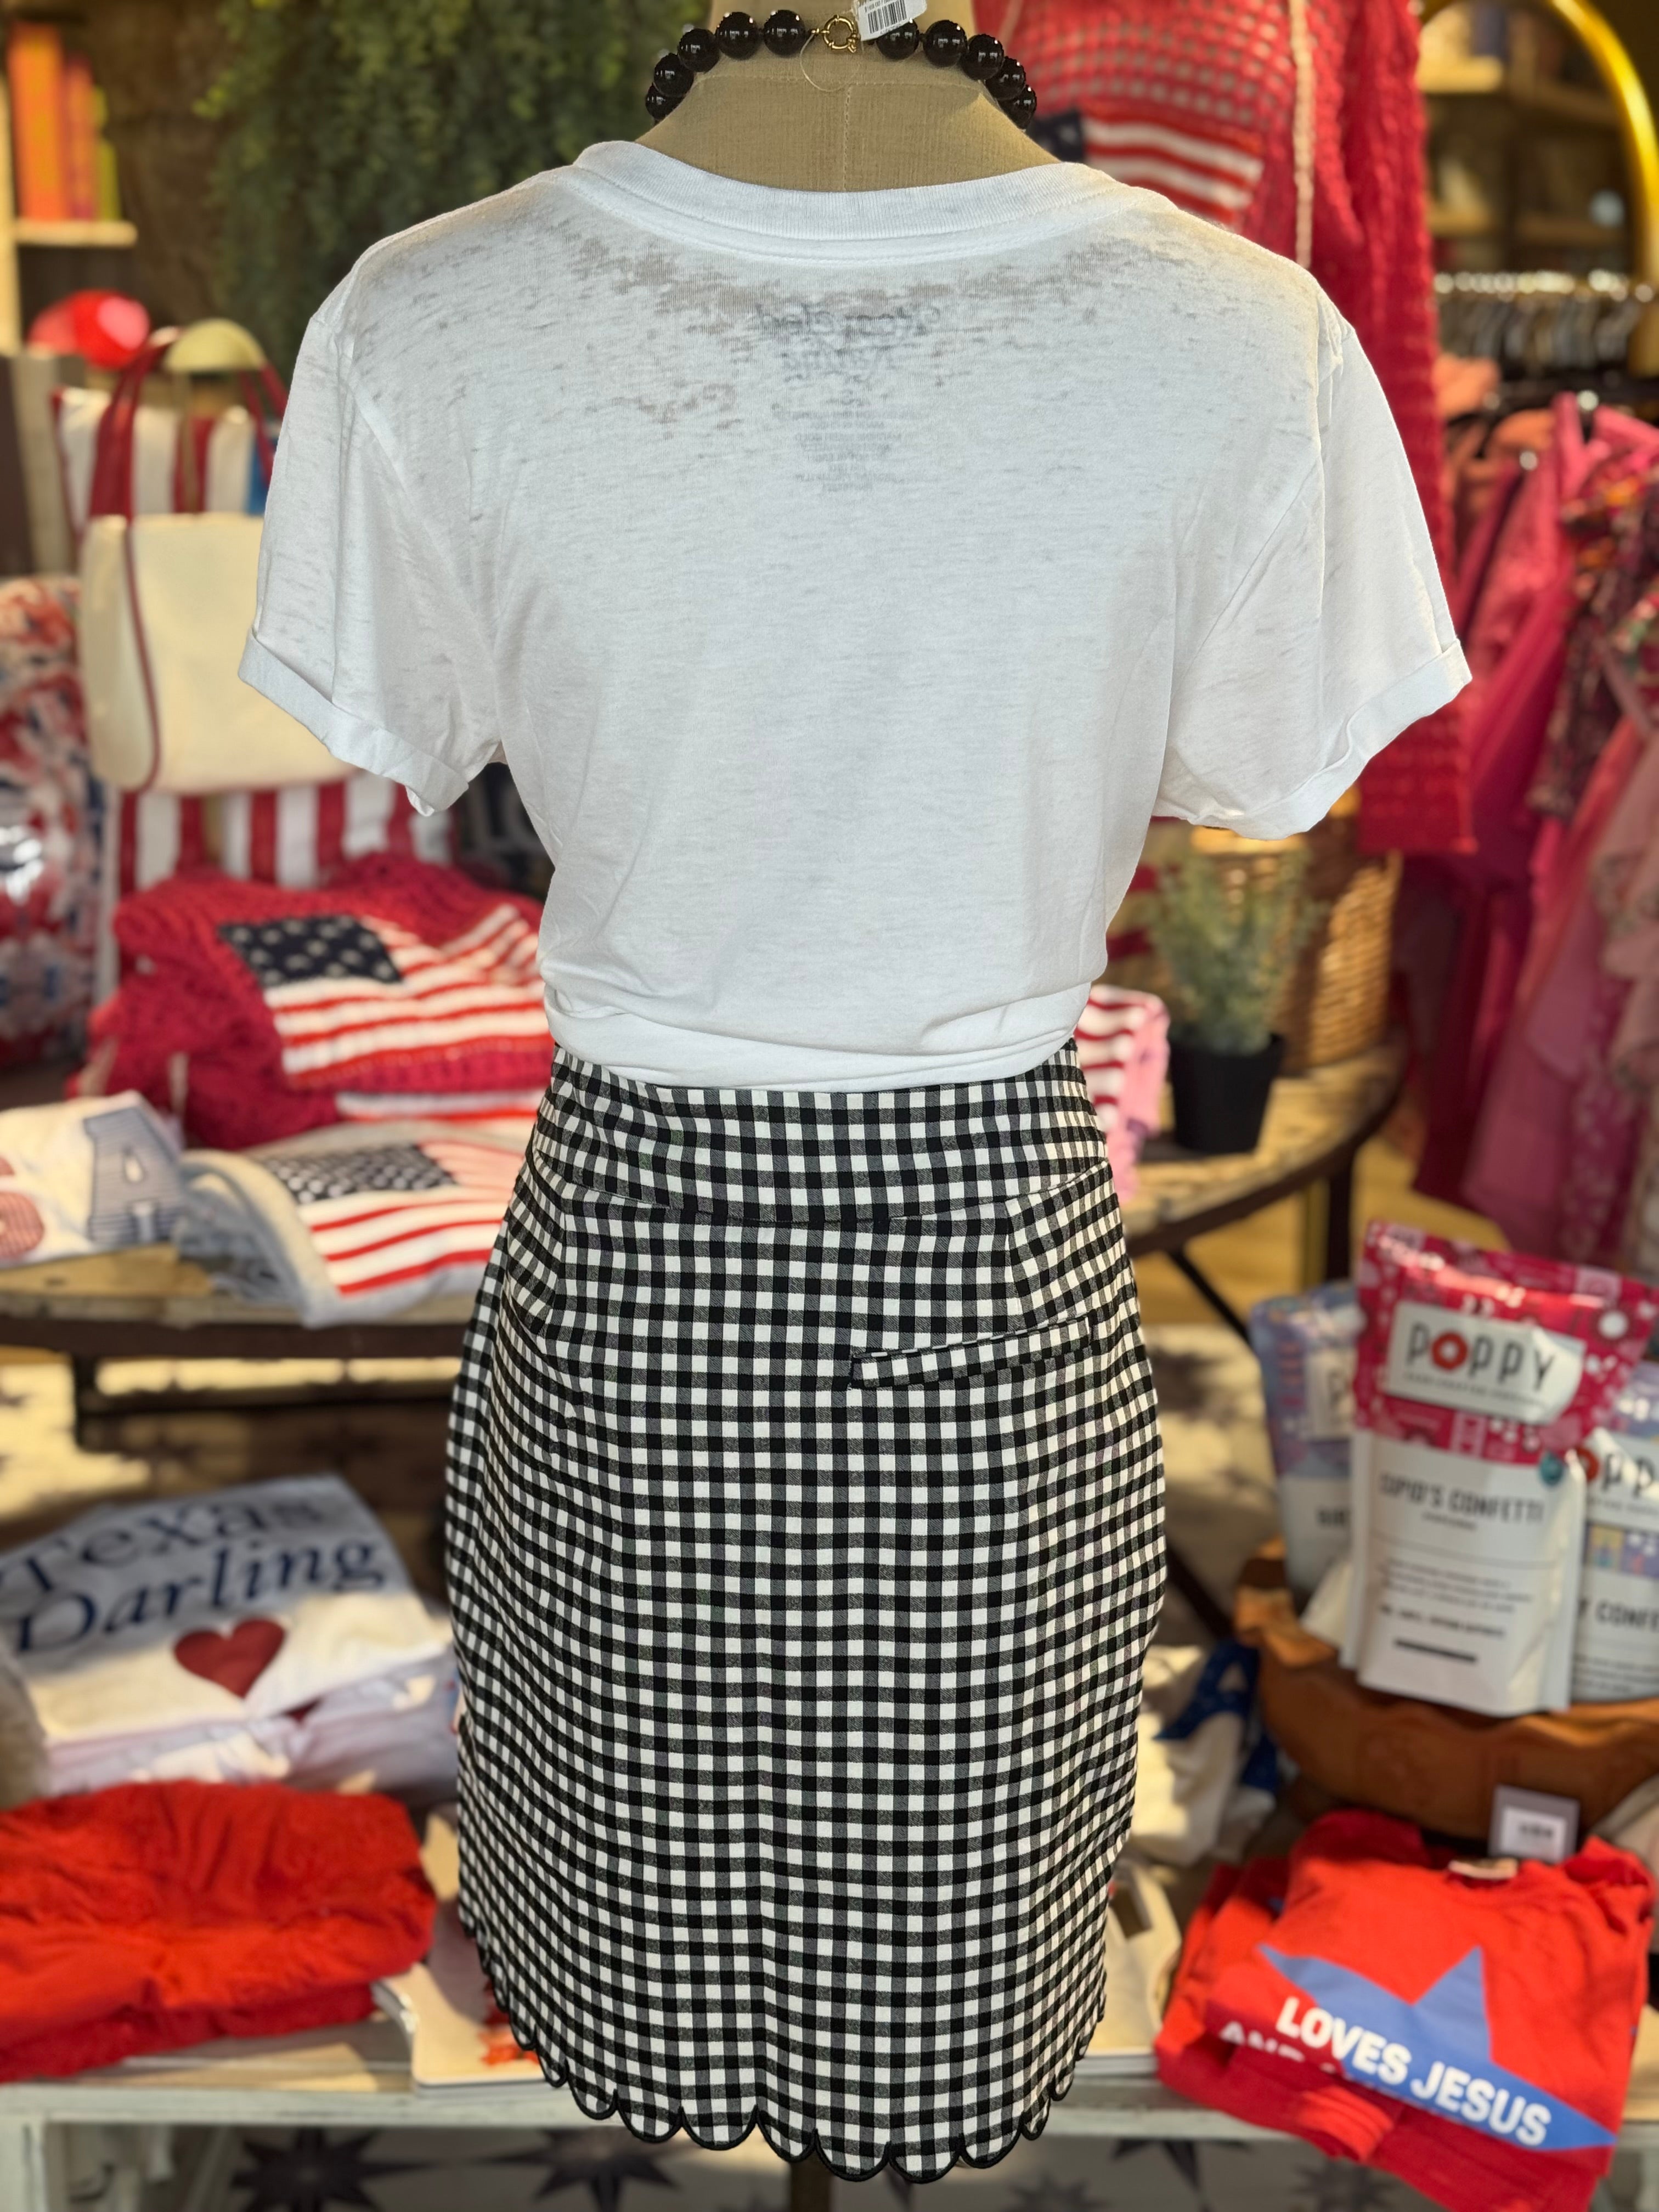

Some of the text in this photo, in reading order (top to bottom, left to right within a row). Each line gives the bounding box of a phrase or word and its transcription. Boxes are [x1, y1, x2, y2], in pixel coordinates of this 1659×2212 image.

[1407, 1321, 1555, 1392] POPPY
[1448, 1488, 1545, 1524] CONFETTI
[15, 1542, 387, 1652] Darling
[1276, 1996, 1413, 2086] LOVES
[1410, 2060, 1552, 2146] JESUS
